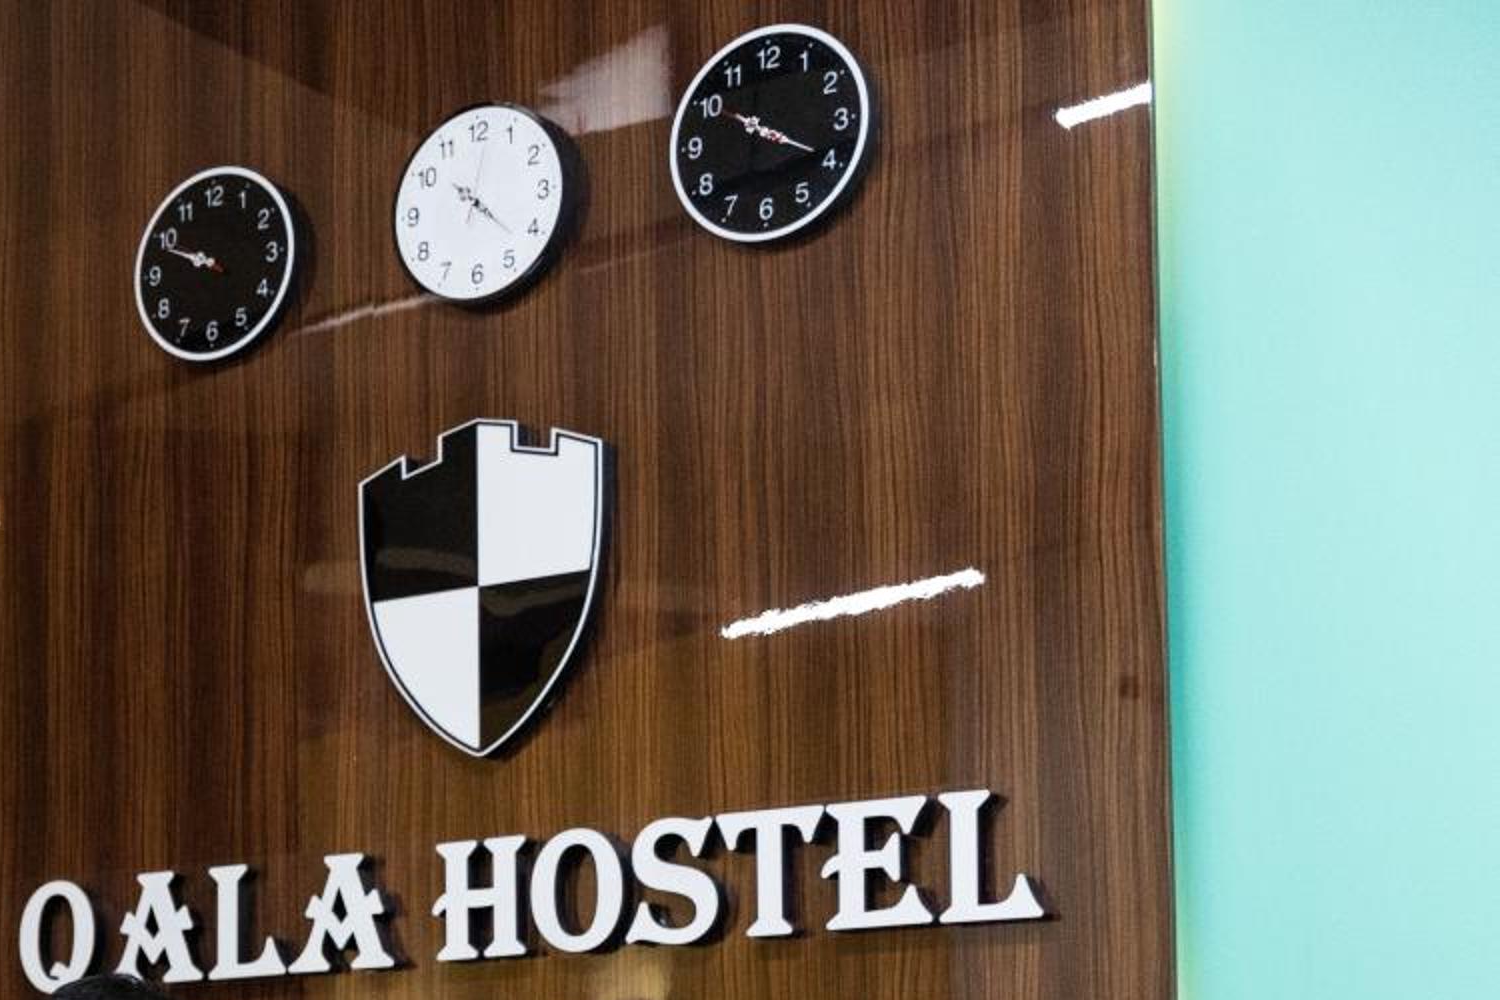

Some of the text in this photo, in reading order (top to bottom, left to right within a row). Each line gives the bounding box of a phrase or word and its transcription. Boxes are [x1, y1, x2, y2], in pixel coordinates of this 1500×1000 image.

[756, 46, 780, 71] 12
[800, 50, 808, 72] 1
[724, 64, 742, 88] 11
[822, 71, 838, 95] 2
[701, 94, 723, 119] 10
[833, 107, 849, 131] 3
[468, 120, 489, 143] 12
[506, 125, 513, 145] 1
[440, 140, 454, 160] 11
[527, 144, 540, 166] 2
[688, 137, 703, 160] 9
[822, 149, 837, 170] 4
[418, 166, 437, 190] 10
[699, 172, 713, 196] 8
[204, 185, 224, 207] 12
[238, 191, 246, 208] 1
[537, 179, 549, 200] 3
[795, 182, 809, 203] 5
[178, 203, 194, 223] 11
[724, 194, 739, 216] 7
[759, 197, 773, 220] 6
[257, 208, 270, 230] 2
[407, 207, 420, 227] 9
[527, 218, 539, 236] 4
[159, 228, 177, 249] 10
[265, 241, 278, 262] 3
[417, 241, 429, 262] 8
[503, 249, 515, 269] 5
[149, 266, 161, 287] 9
[440, 261, 452, 281] 7
[471, 263, 484, 284] 6
[256, 278, 268, 297] 4
[157, 298, 170, 319] 8
[235, 307, 247, 326] 5
[179, 318, 190, 337] 7
[205, 320, 219, 341] 6
[431, 788, 1044, 962] HOSTEL
